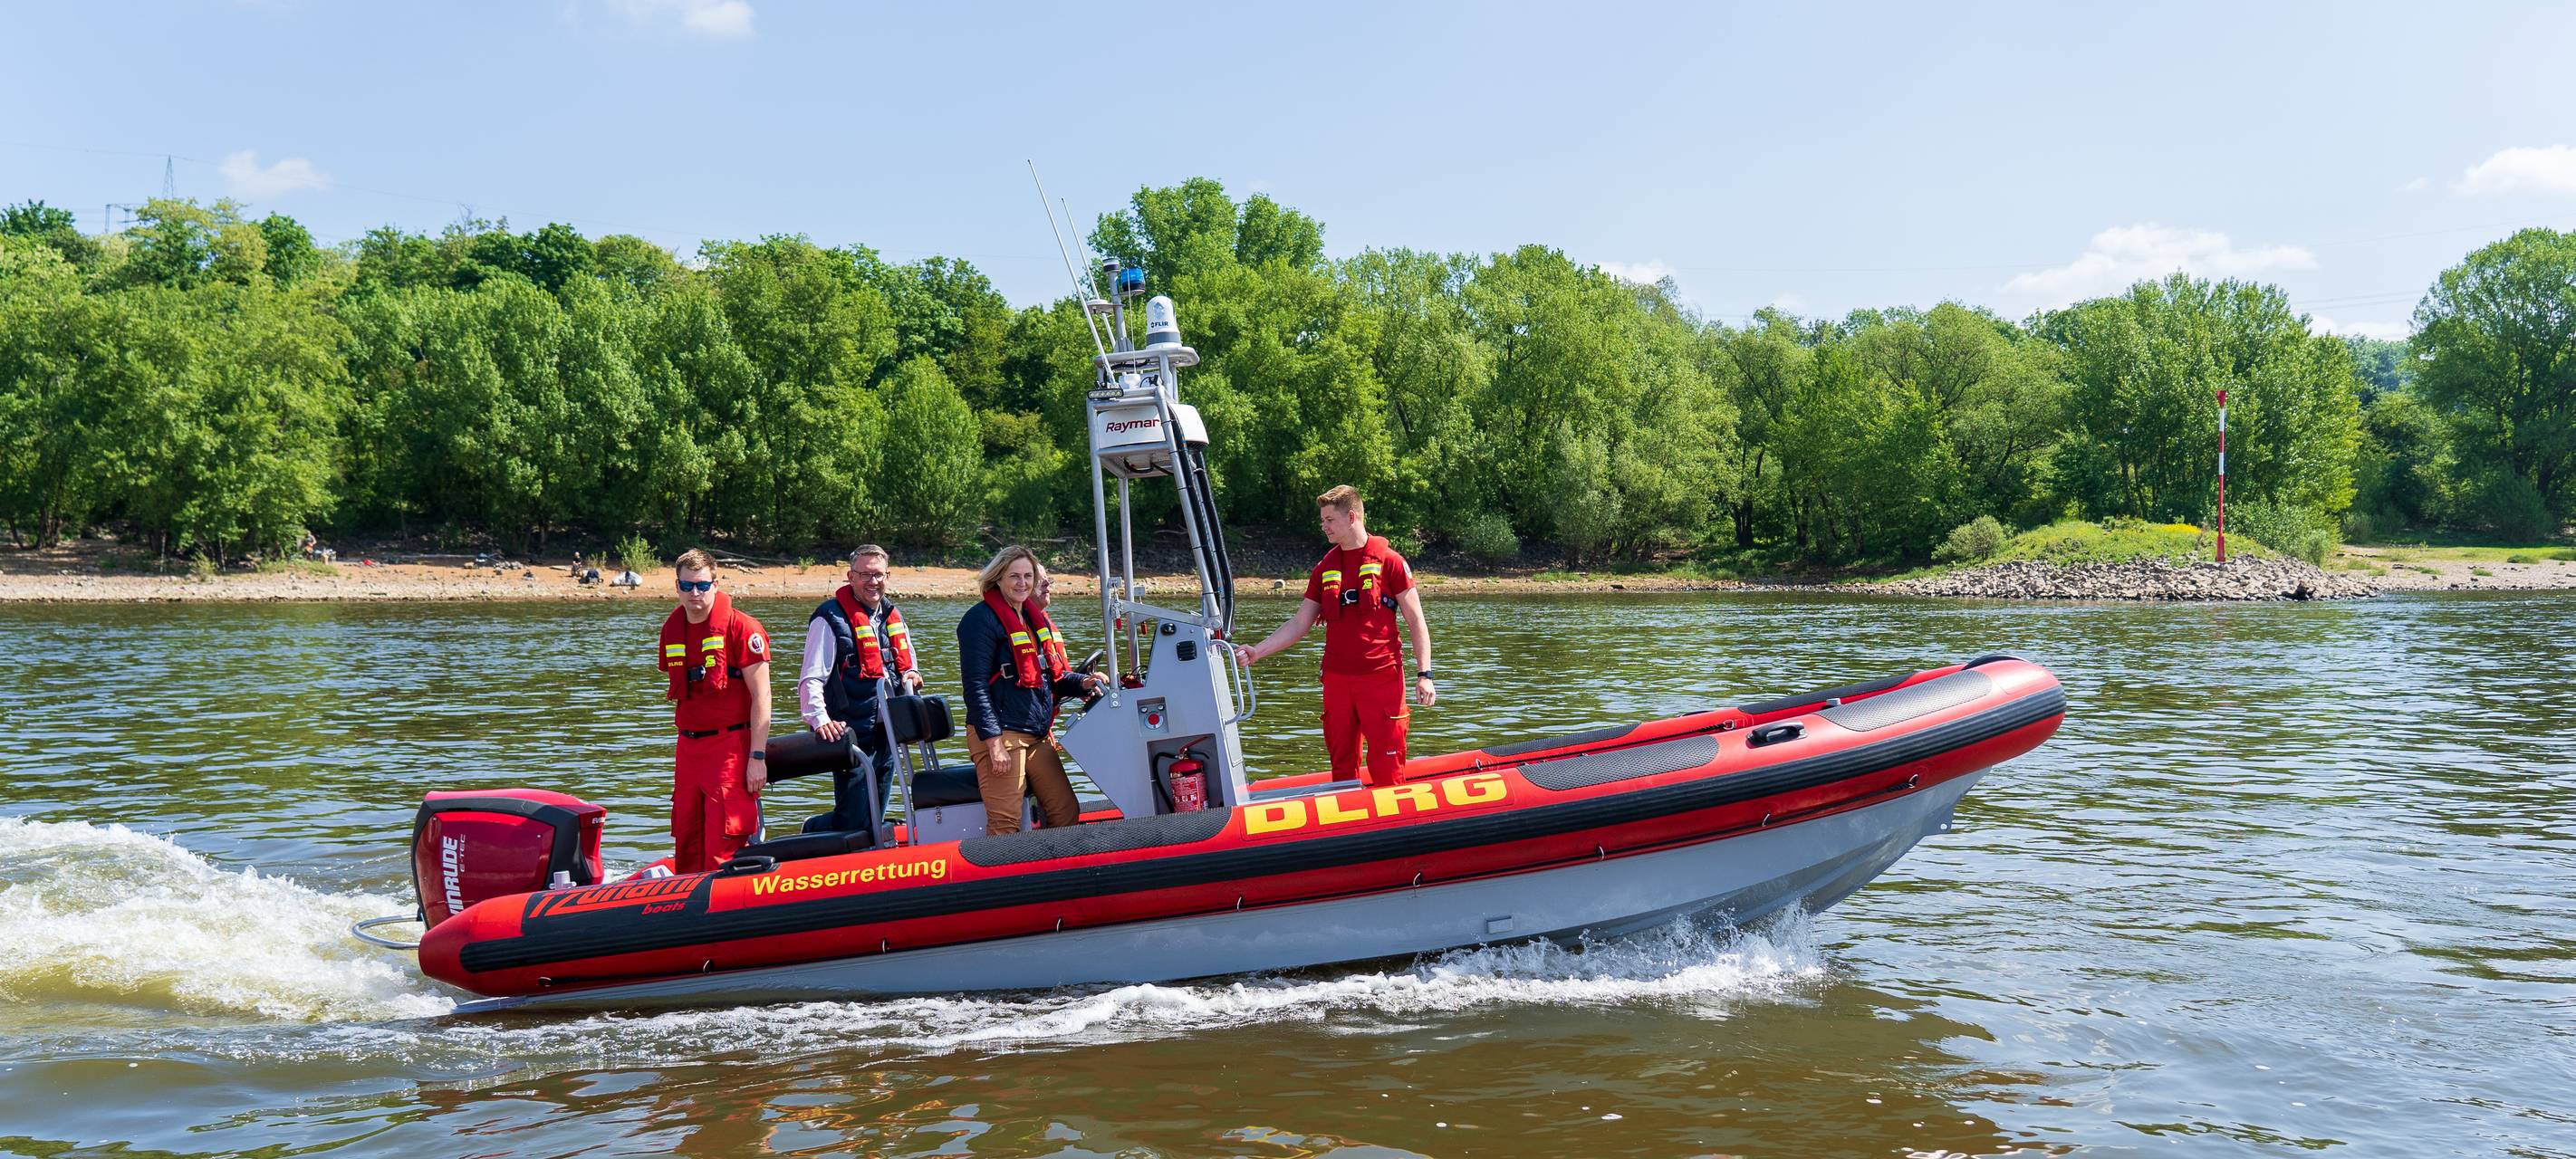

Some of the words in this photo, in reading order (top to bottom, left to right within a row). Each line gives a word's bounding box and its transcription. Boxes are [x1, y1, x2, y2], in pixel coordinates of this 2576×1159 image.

[1106, 418, 1160, 434] Raymar
[1244, 773, 1507, 835] DLRG
[443, 835, 464, 915] INRUDE
[753, 858, 947, 896] Wasserrettung
[641, 902, 685, 915] boats
